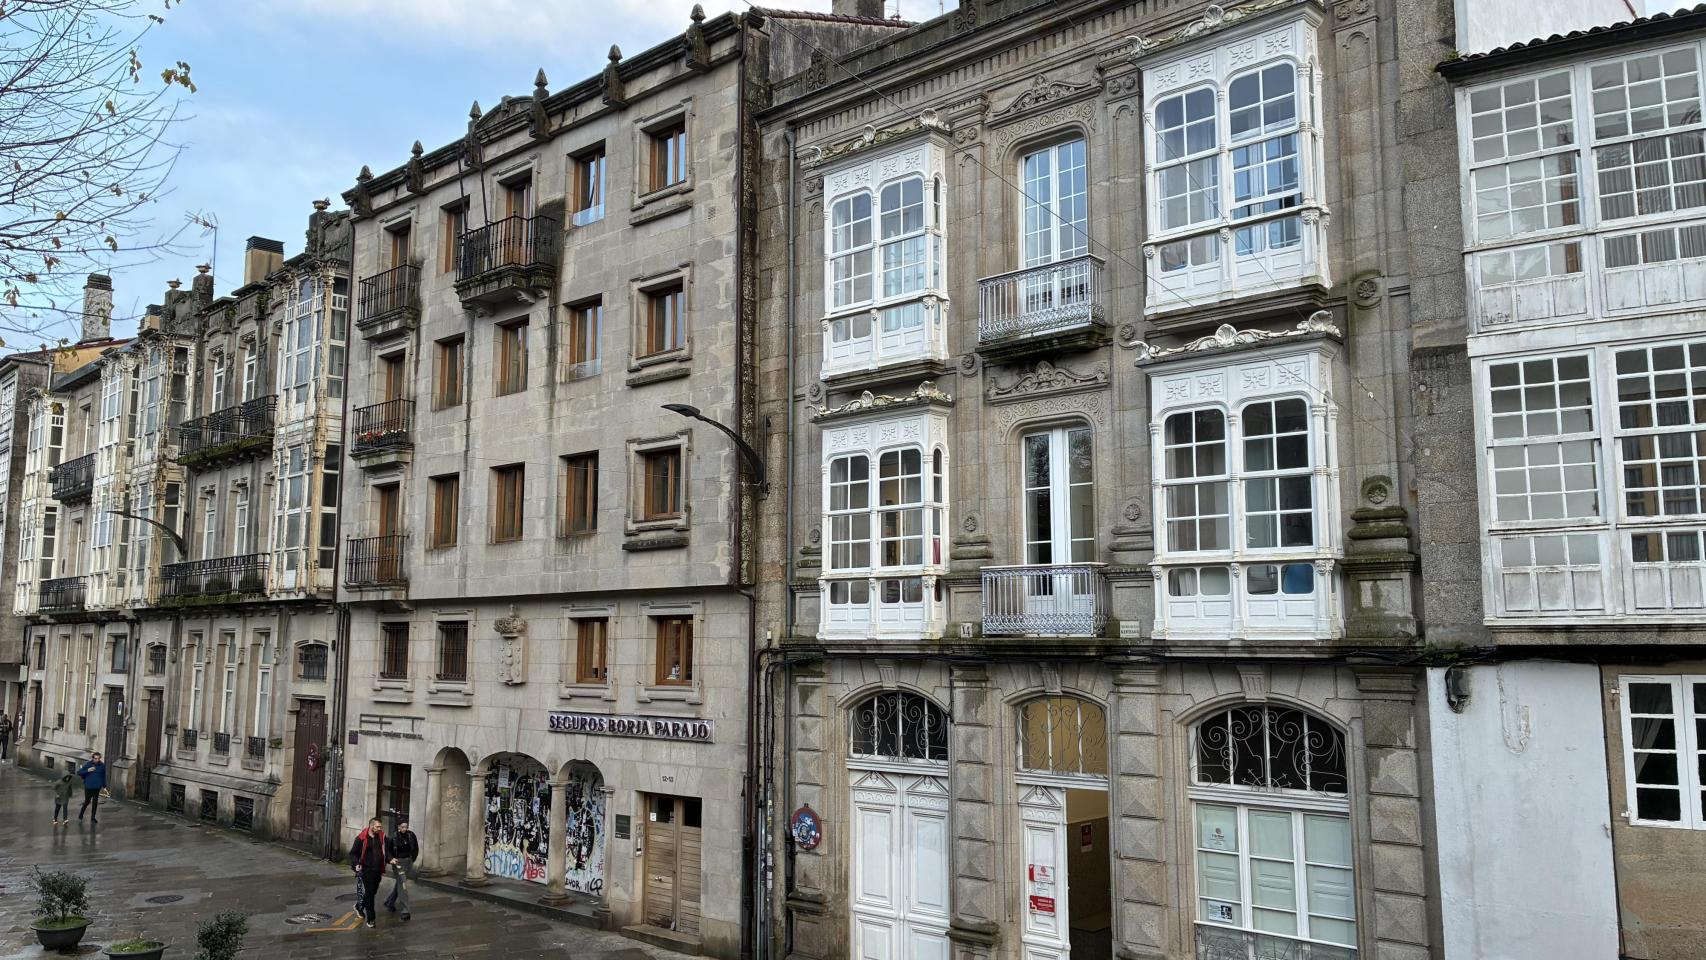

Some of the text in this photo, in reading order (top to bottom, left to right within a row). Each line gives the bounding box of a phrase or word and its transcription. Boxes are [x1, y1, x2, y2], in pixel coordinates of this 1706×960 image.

[549, 715, 710, 739] SEGUROS BORJA PARAJÓ
